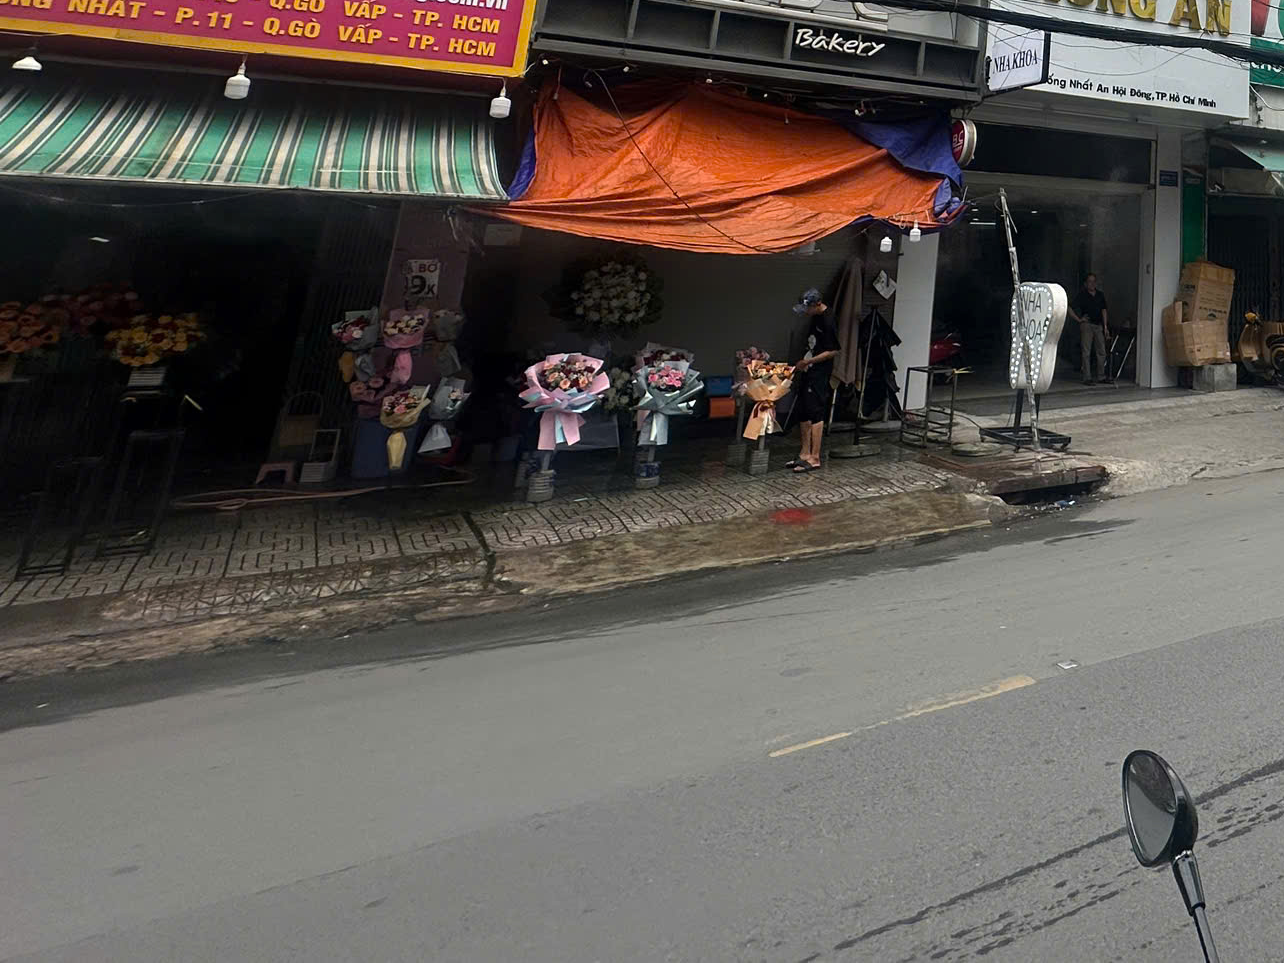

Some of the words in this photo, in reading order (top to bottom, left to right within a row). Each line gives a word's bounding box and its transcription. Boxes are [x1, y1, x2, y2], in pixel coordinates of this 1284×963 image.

[412, 9, 443, 29] TP.
[452, 13, 501, 35] HCM
[338, 22, 383, 44] VẤP
[407, 32, 439, 51] TP.
[447, 38, 496, 57] HCM
[795, 27, 886, 57] Bakery
[993, 56, 1011, 74] NHA
[1011, 49, 1038, 71] KHOA
[1069, 77, 1093, 91] Nhất
[1096, 83, 1109, 94] An
[1112, 85, 1127, 97] Hội
